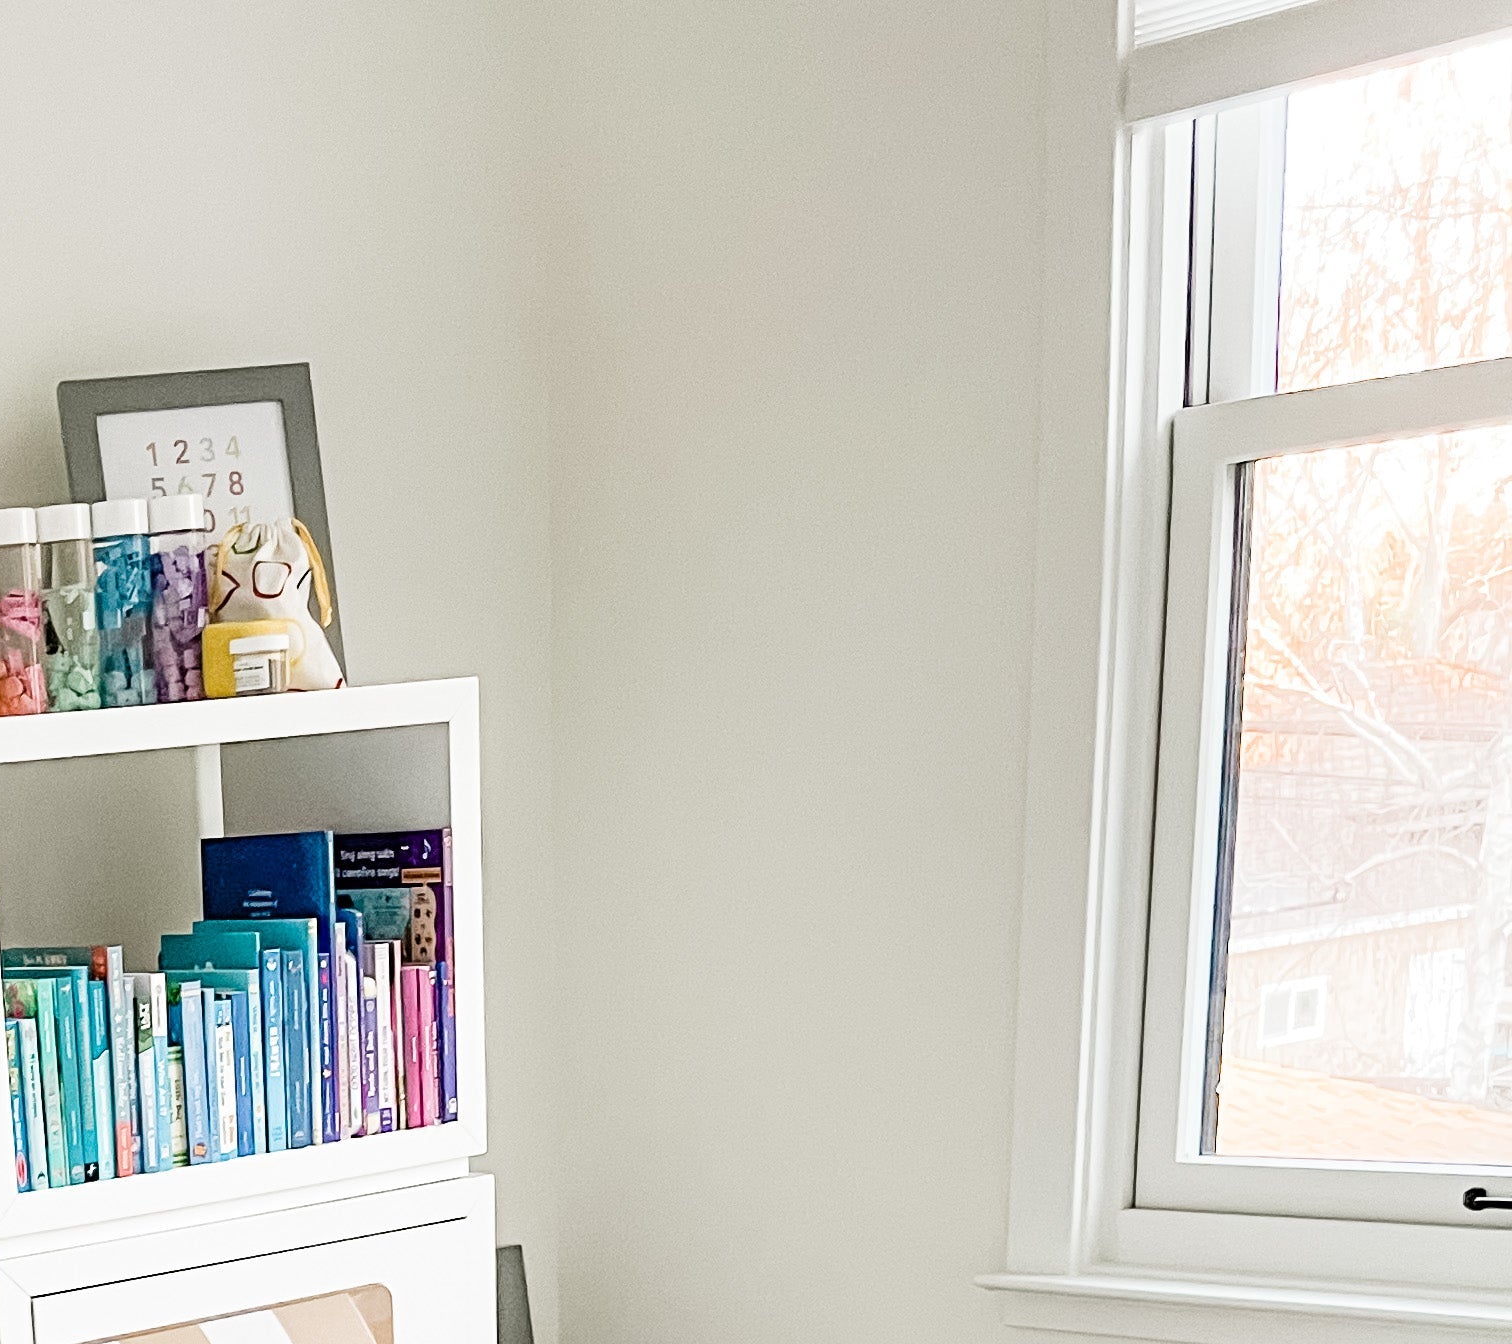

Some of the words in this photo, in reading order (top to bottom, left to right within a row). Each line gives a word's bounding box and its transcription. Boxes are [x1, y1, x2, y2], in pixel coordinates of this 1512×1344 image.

[146, 442, 158, 466] 1
[174, 439, 190, 464] 2
[199, 437, 215, 462] 3
[225, 435, 241, 458] 4
[201, 473, 217, 497] 7
[229, 471, 244, 495] 8
